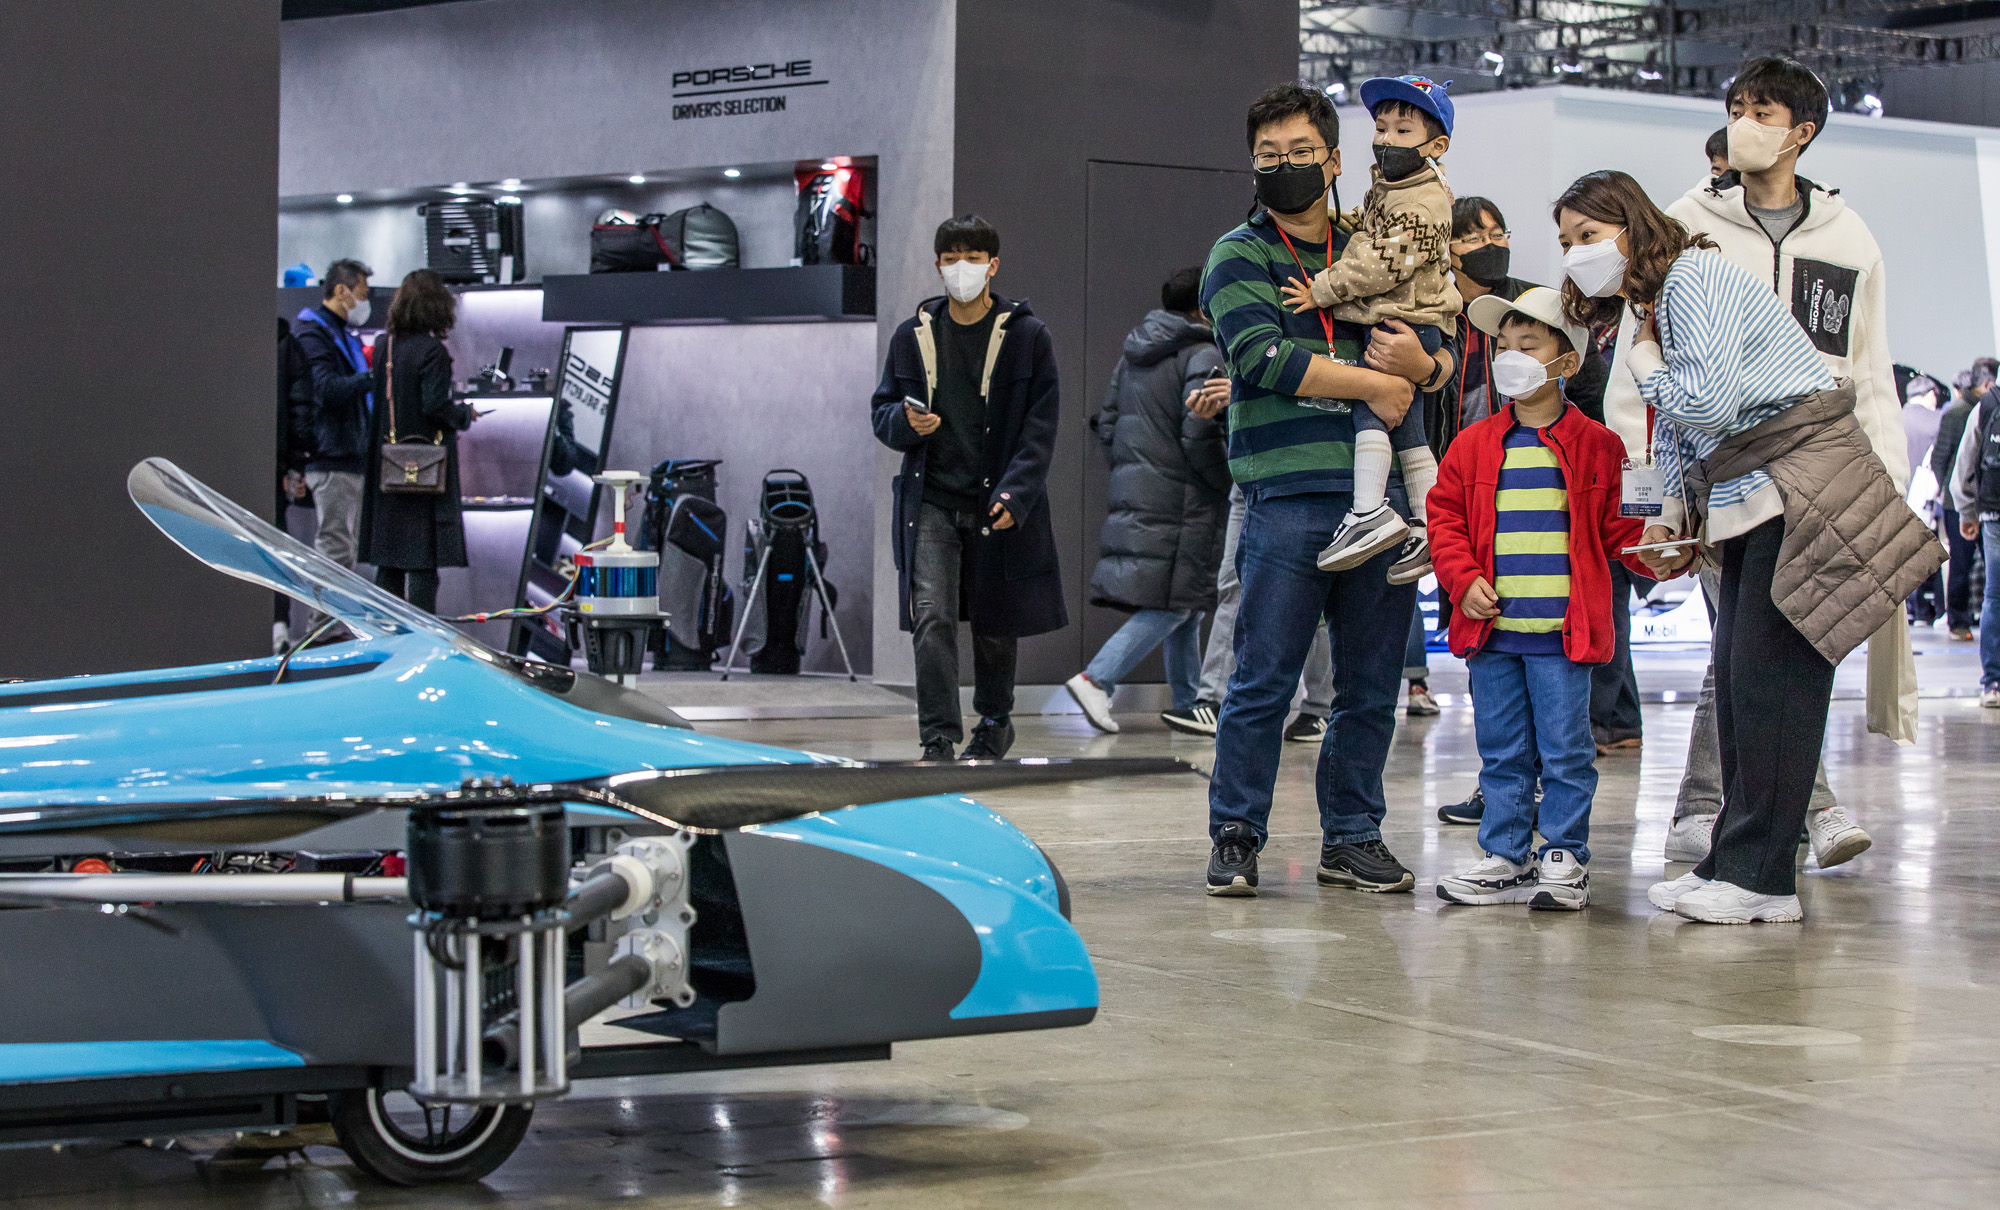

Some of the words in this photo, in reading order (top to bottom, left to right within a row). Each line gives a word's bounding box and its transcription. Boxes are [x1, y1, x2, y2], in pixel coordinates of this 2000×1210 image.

[672, 60, 812, 88] PORSCHE
[672, 101, 722, 120] DRIVER'S
[723, 96, 786, 116] SELECTION
[1811, 278, 1824, 333] LIFEWORK
[1644, 624, 1677, 637] Mobil
